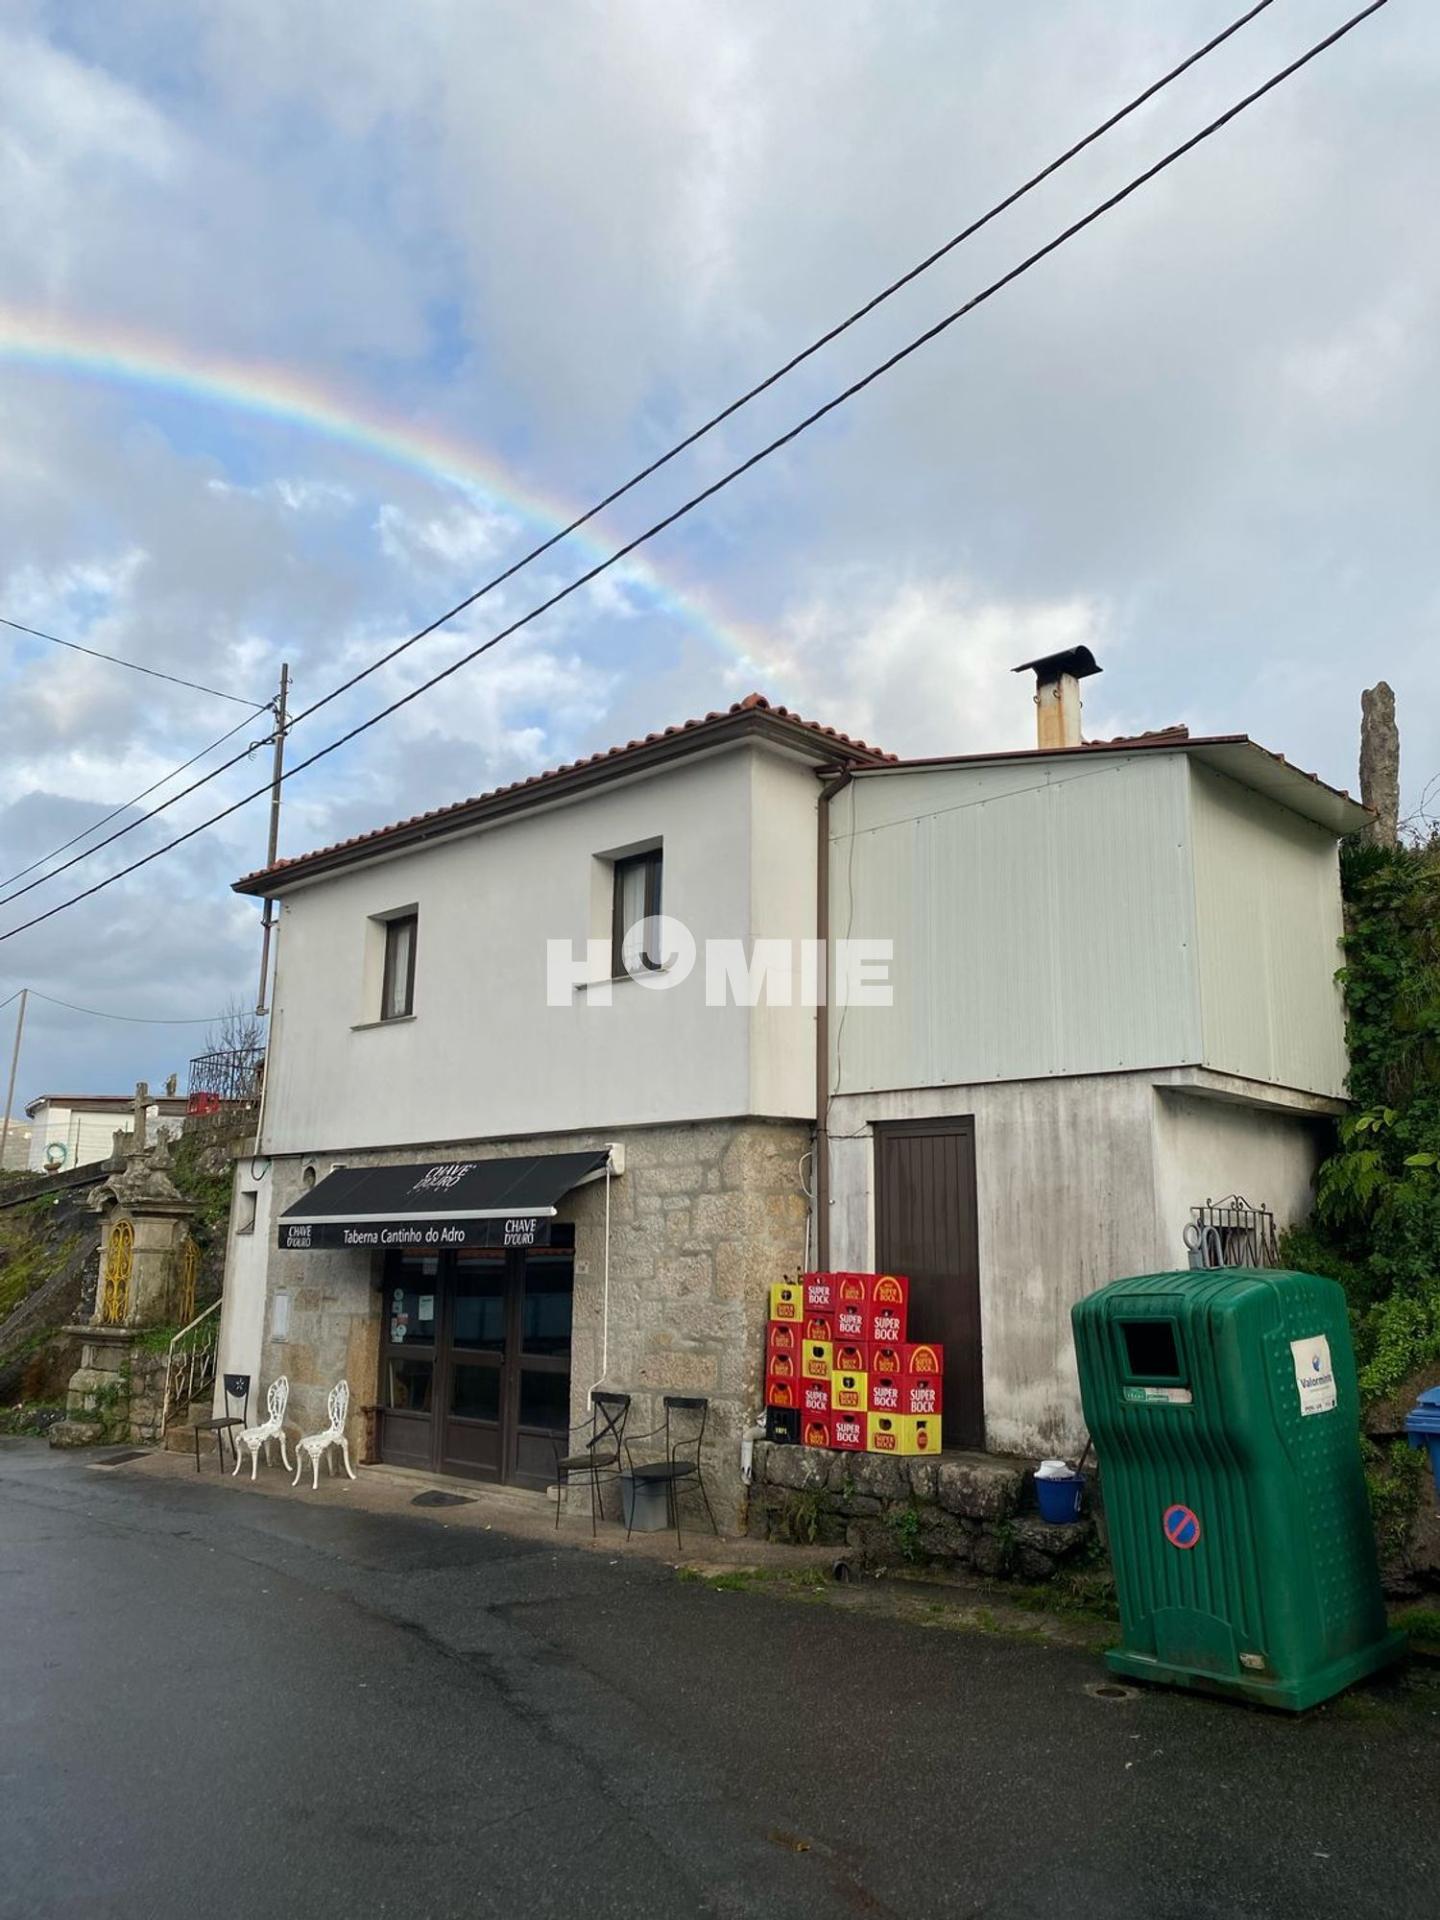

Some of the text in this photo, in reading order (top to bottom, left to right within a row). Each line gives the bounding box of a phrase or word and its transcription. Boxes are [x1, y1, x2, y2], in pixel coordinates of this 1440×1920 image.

[288, 1225, 312, 1237] CHAVE
[505, 1219, 537, 1233] CHAVE
[343, 1226, 466, 1244] Taberna Cantinho do Adro
[504, 1233, 534, 1245] D'OURO
[808, 1286, 830, 1296] SUPER
[808, 1295, 829, 1304] BOCK
[839, 1313, 863, 1325] SUPER
[874, 1316, 900, 1329] SUPER
[839, 1322, 861, 1334] BOCK
[874, 1328, 898, 1341] BOCK
[805, 1390, 828, 1401] SUPER
[873, 1387, 898, 1398] SUPER
[910, 1389, 936, 1401] SUPER
[805, 1399, 827, 1411] BOCK
[874, 1396, 897, 1408] BOCK
[910, 1400, 934, 1413] BOCK
[835, 1423, 860, 1434] SUPER
[836, 1431, 860, 1443] BOCK
